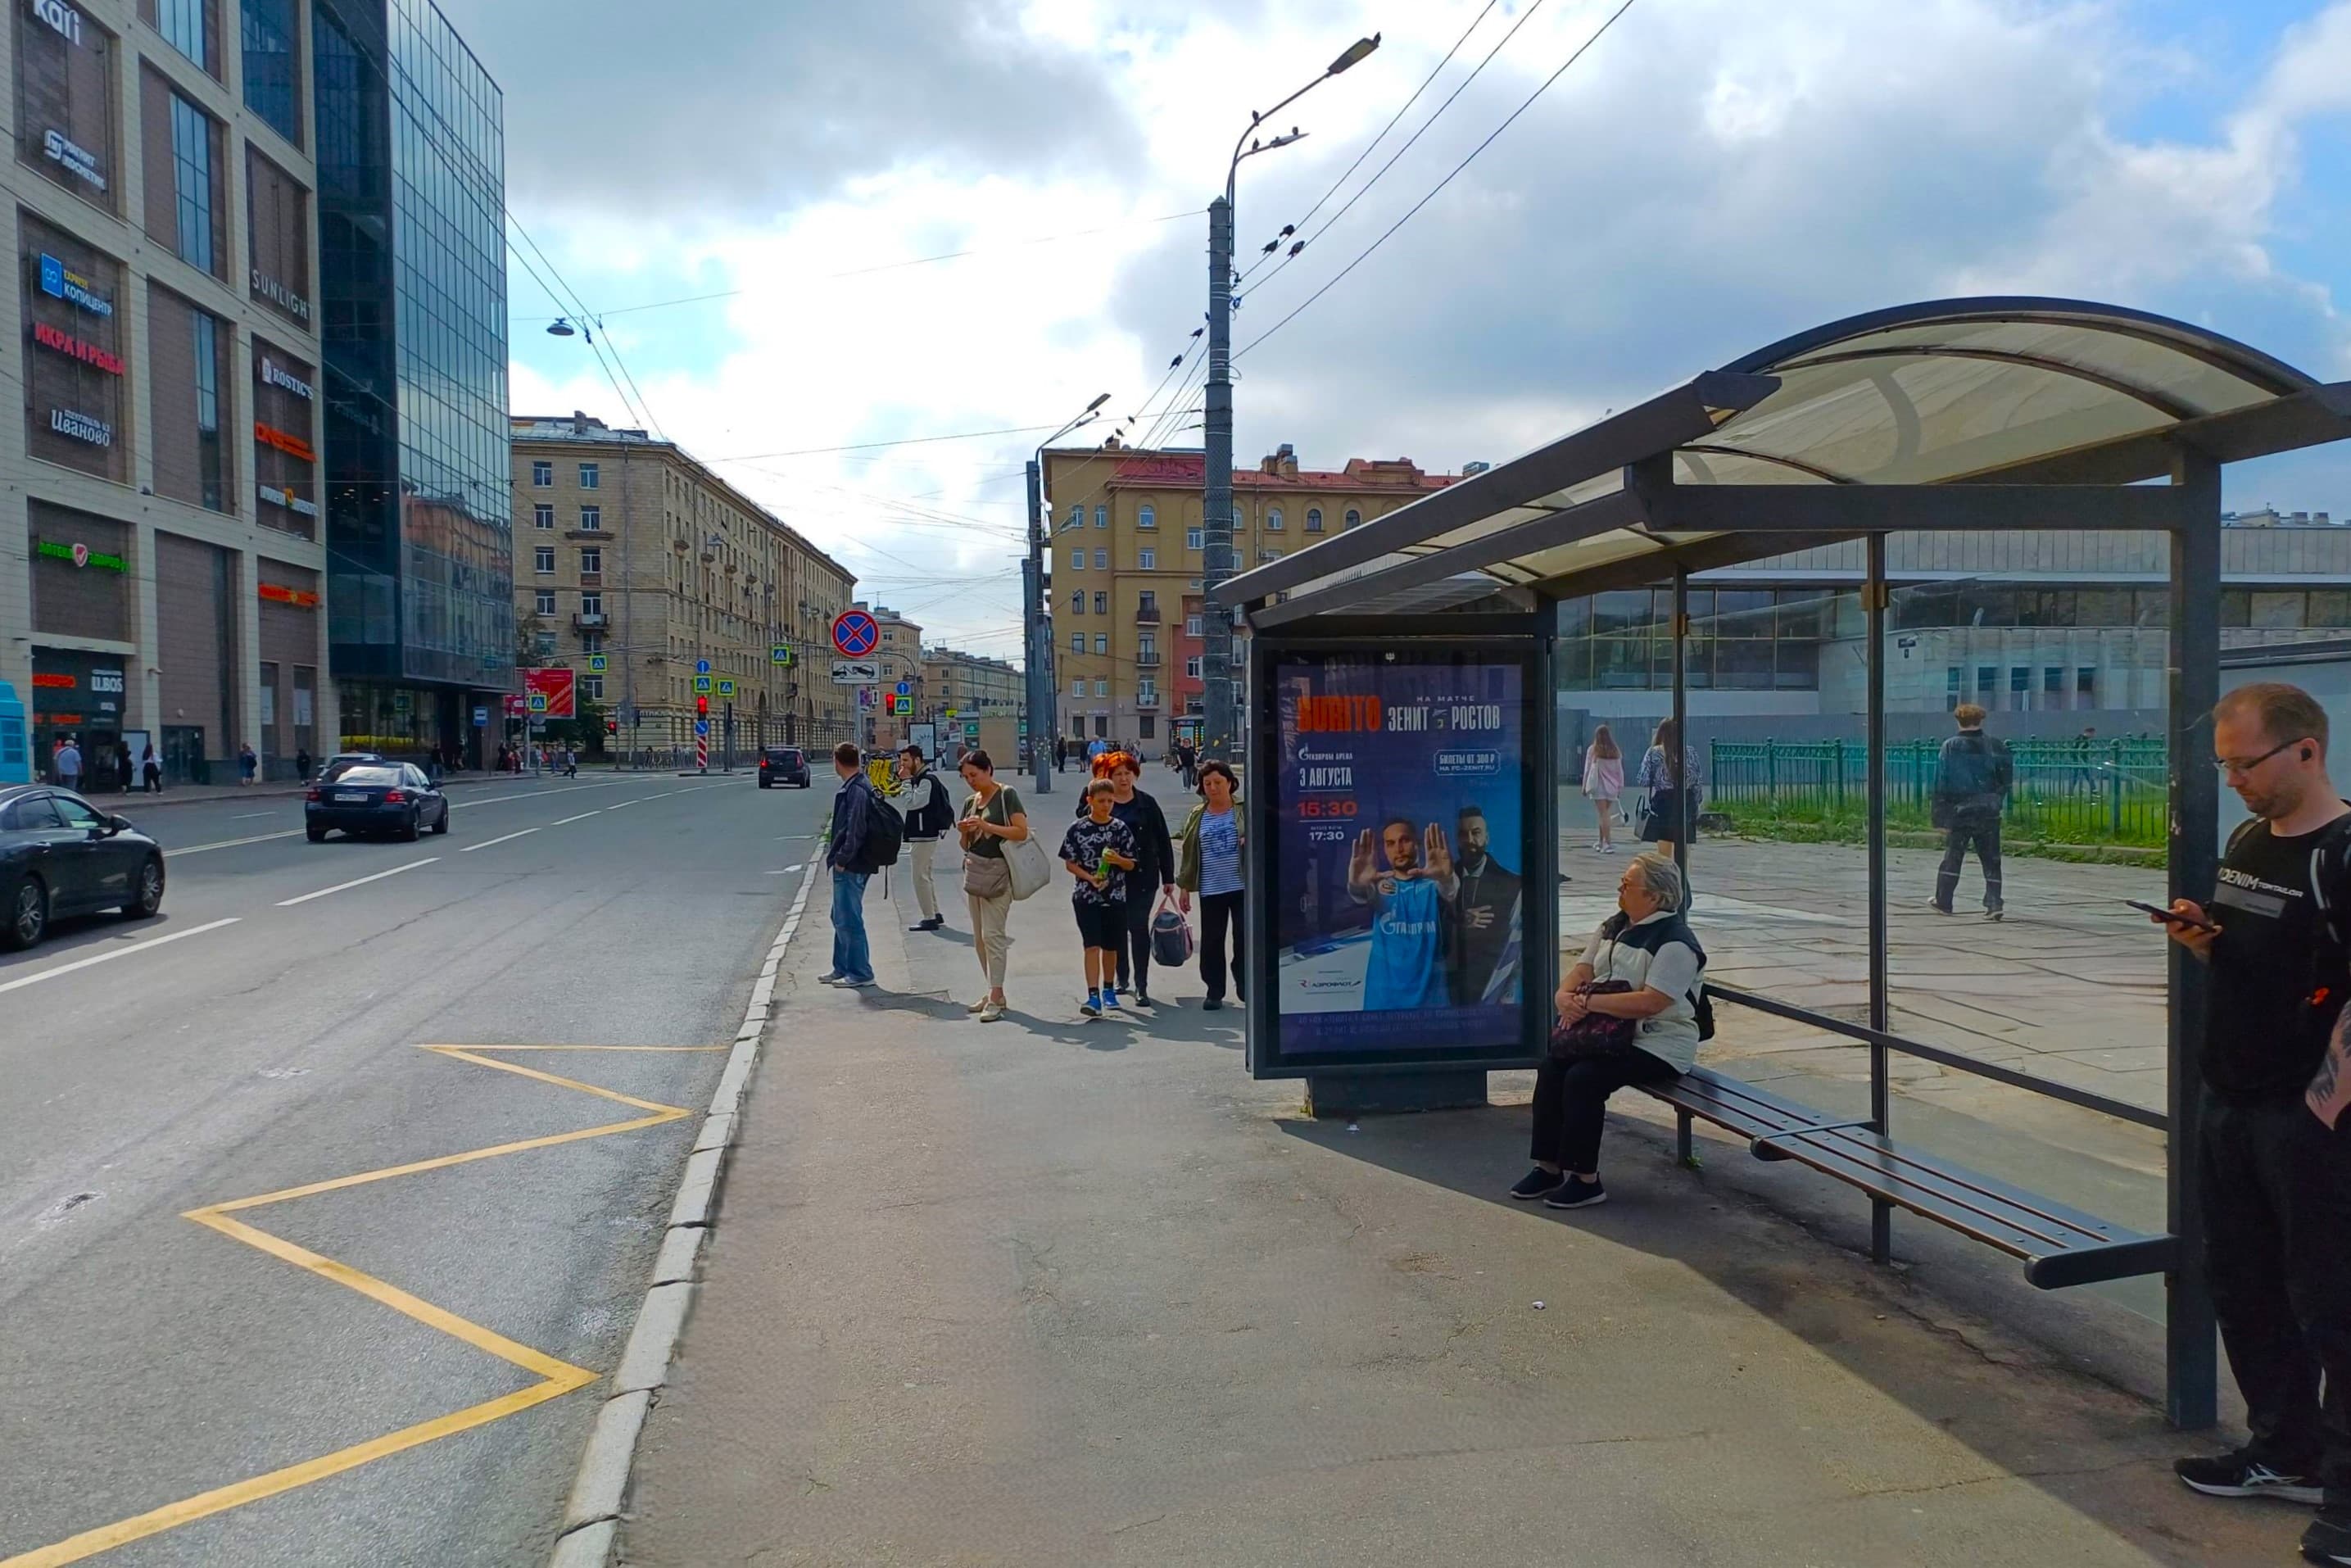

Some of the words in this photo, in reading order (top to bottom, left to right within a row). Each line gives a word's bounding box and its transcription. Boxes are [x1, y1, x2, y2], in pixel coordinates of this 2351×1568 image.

[64, 282, 112, 316] КОПИЦЕНТР
[252, 269, 313, 322] SUNLIGHT
[34, 321, 75, 356] ИКРА
[1388, 706, 1429, 732] ЗЕНИТ
[1452, 705, 1500, 730] РОСТОВ
[1439, 754, 1465, 764] БИЛЕТЫ
[1466, 754, 1475, 764] ОТ
[1299, 768, 1306, 786] 3
[1309, 767, 1352, 787] АВГУСТА
[1298, 800, 1358, 817] 15:30
[1309, 831, 1345, 841] 17:30
